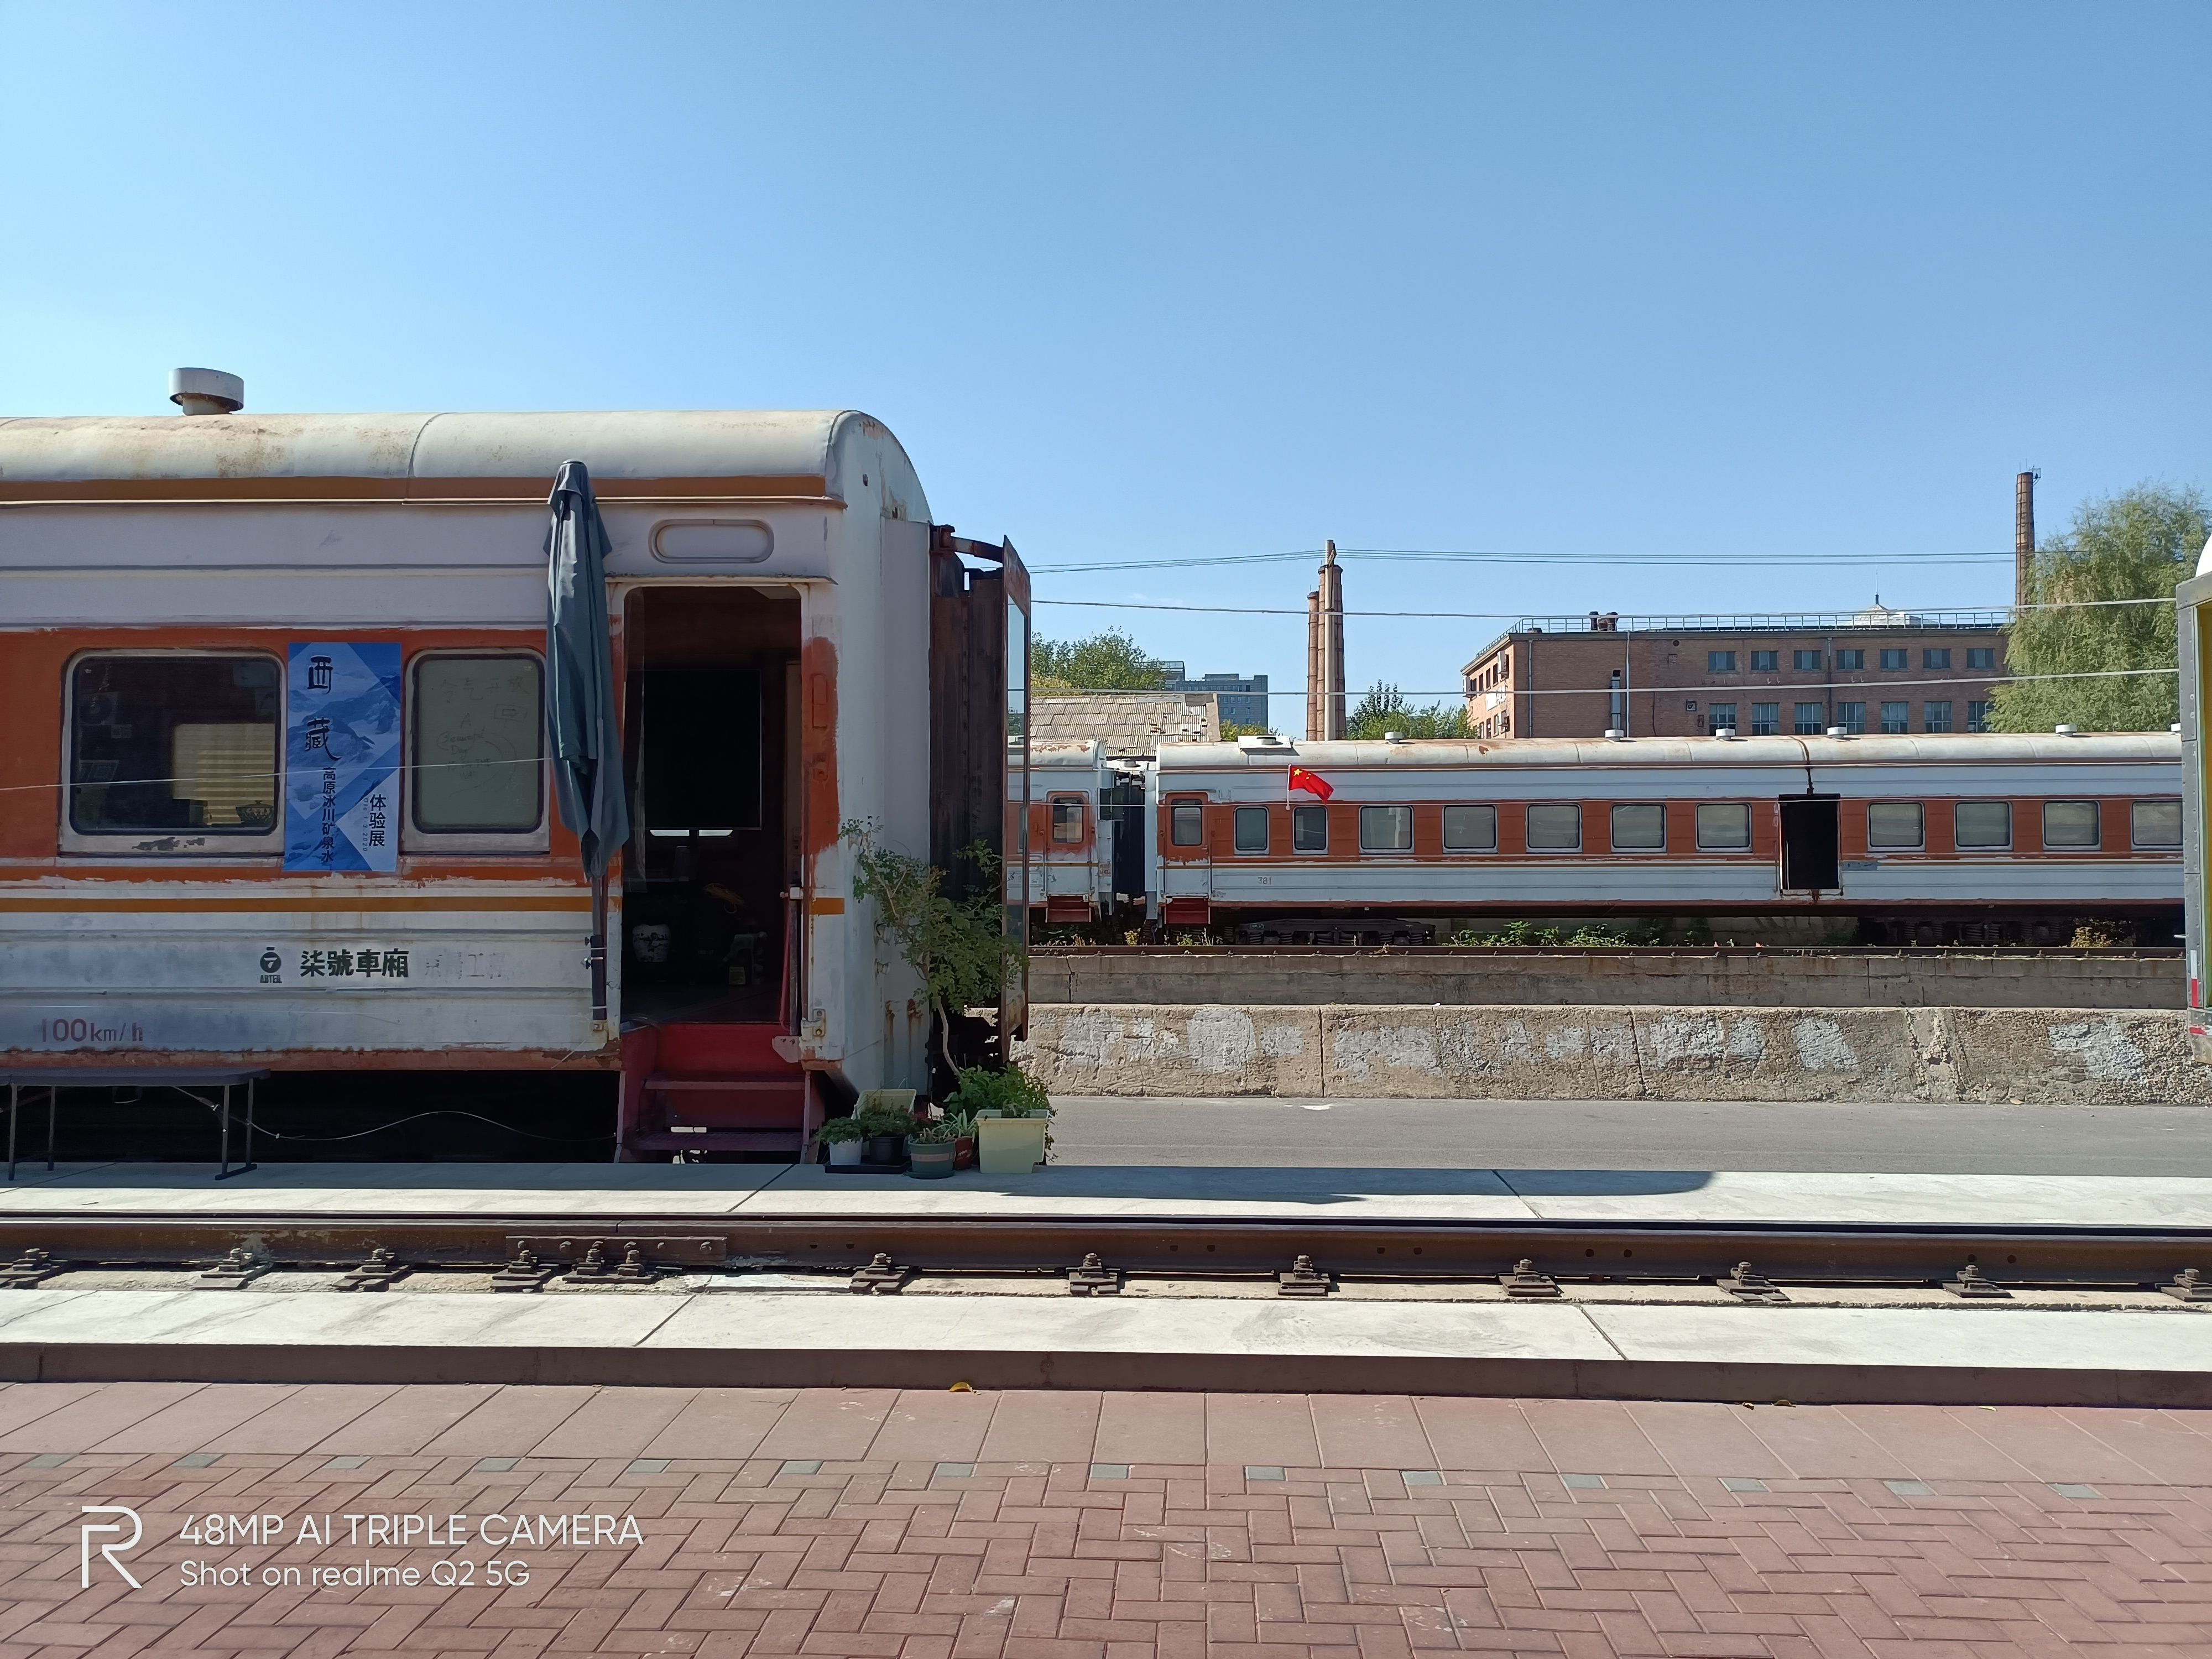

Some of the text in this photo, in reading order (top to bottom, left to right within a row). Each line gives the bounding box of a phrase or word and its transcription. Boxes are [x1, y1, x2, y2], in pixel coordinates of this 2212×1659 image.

[305, 655, 342, 761] 西藏
[321, 767, 336, 863] 高原冰川矿泉水
[369, 794, 387, 847] 体验展
[300, 948, 409, 978] 柒號車廂
